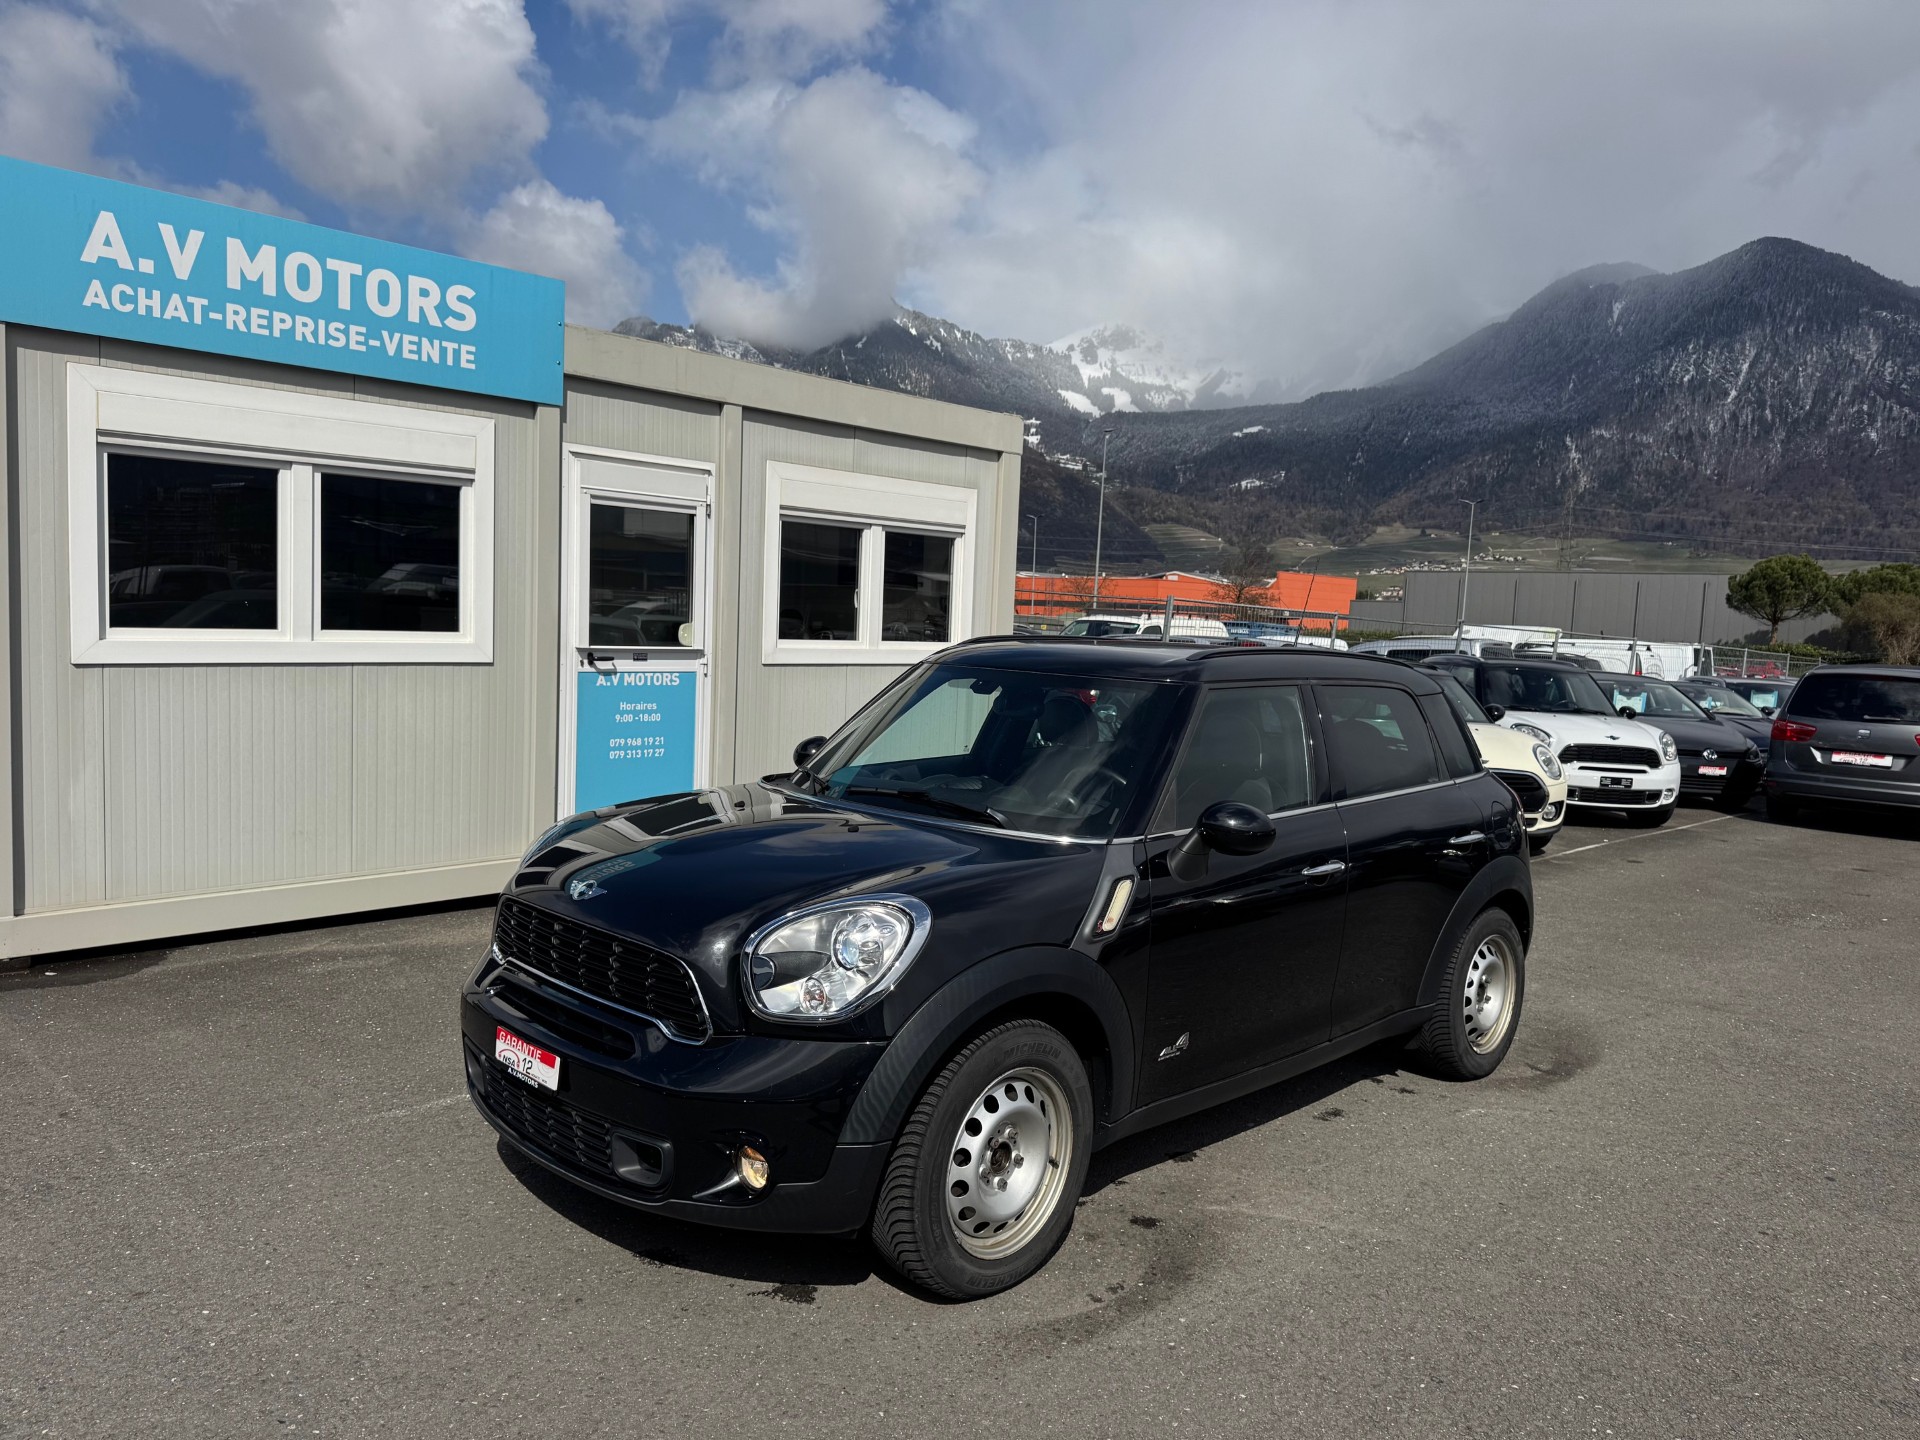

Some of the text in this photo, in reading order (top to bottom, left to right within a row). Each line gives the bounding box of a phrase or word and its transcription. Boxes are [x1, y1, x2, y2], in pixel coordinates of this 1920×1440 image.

[80, 210, 477, 332] A.V MOTORS
[82, 279, 476, 370] ACHAT-REPRISE-VENTE
[596, 673, 680, 687] A.V MOTORS
[620, 702, 657, 711] Horaires
[615, 714, 633, 723] 9:00
[609, 736, 664, 747] 079 968 19 21
[609, 748, 665, 759] 079 313 17 27
[500, 1031, 542, 1060] GARANTIE
[503, 1054, 533, 1075] NSA 12
